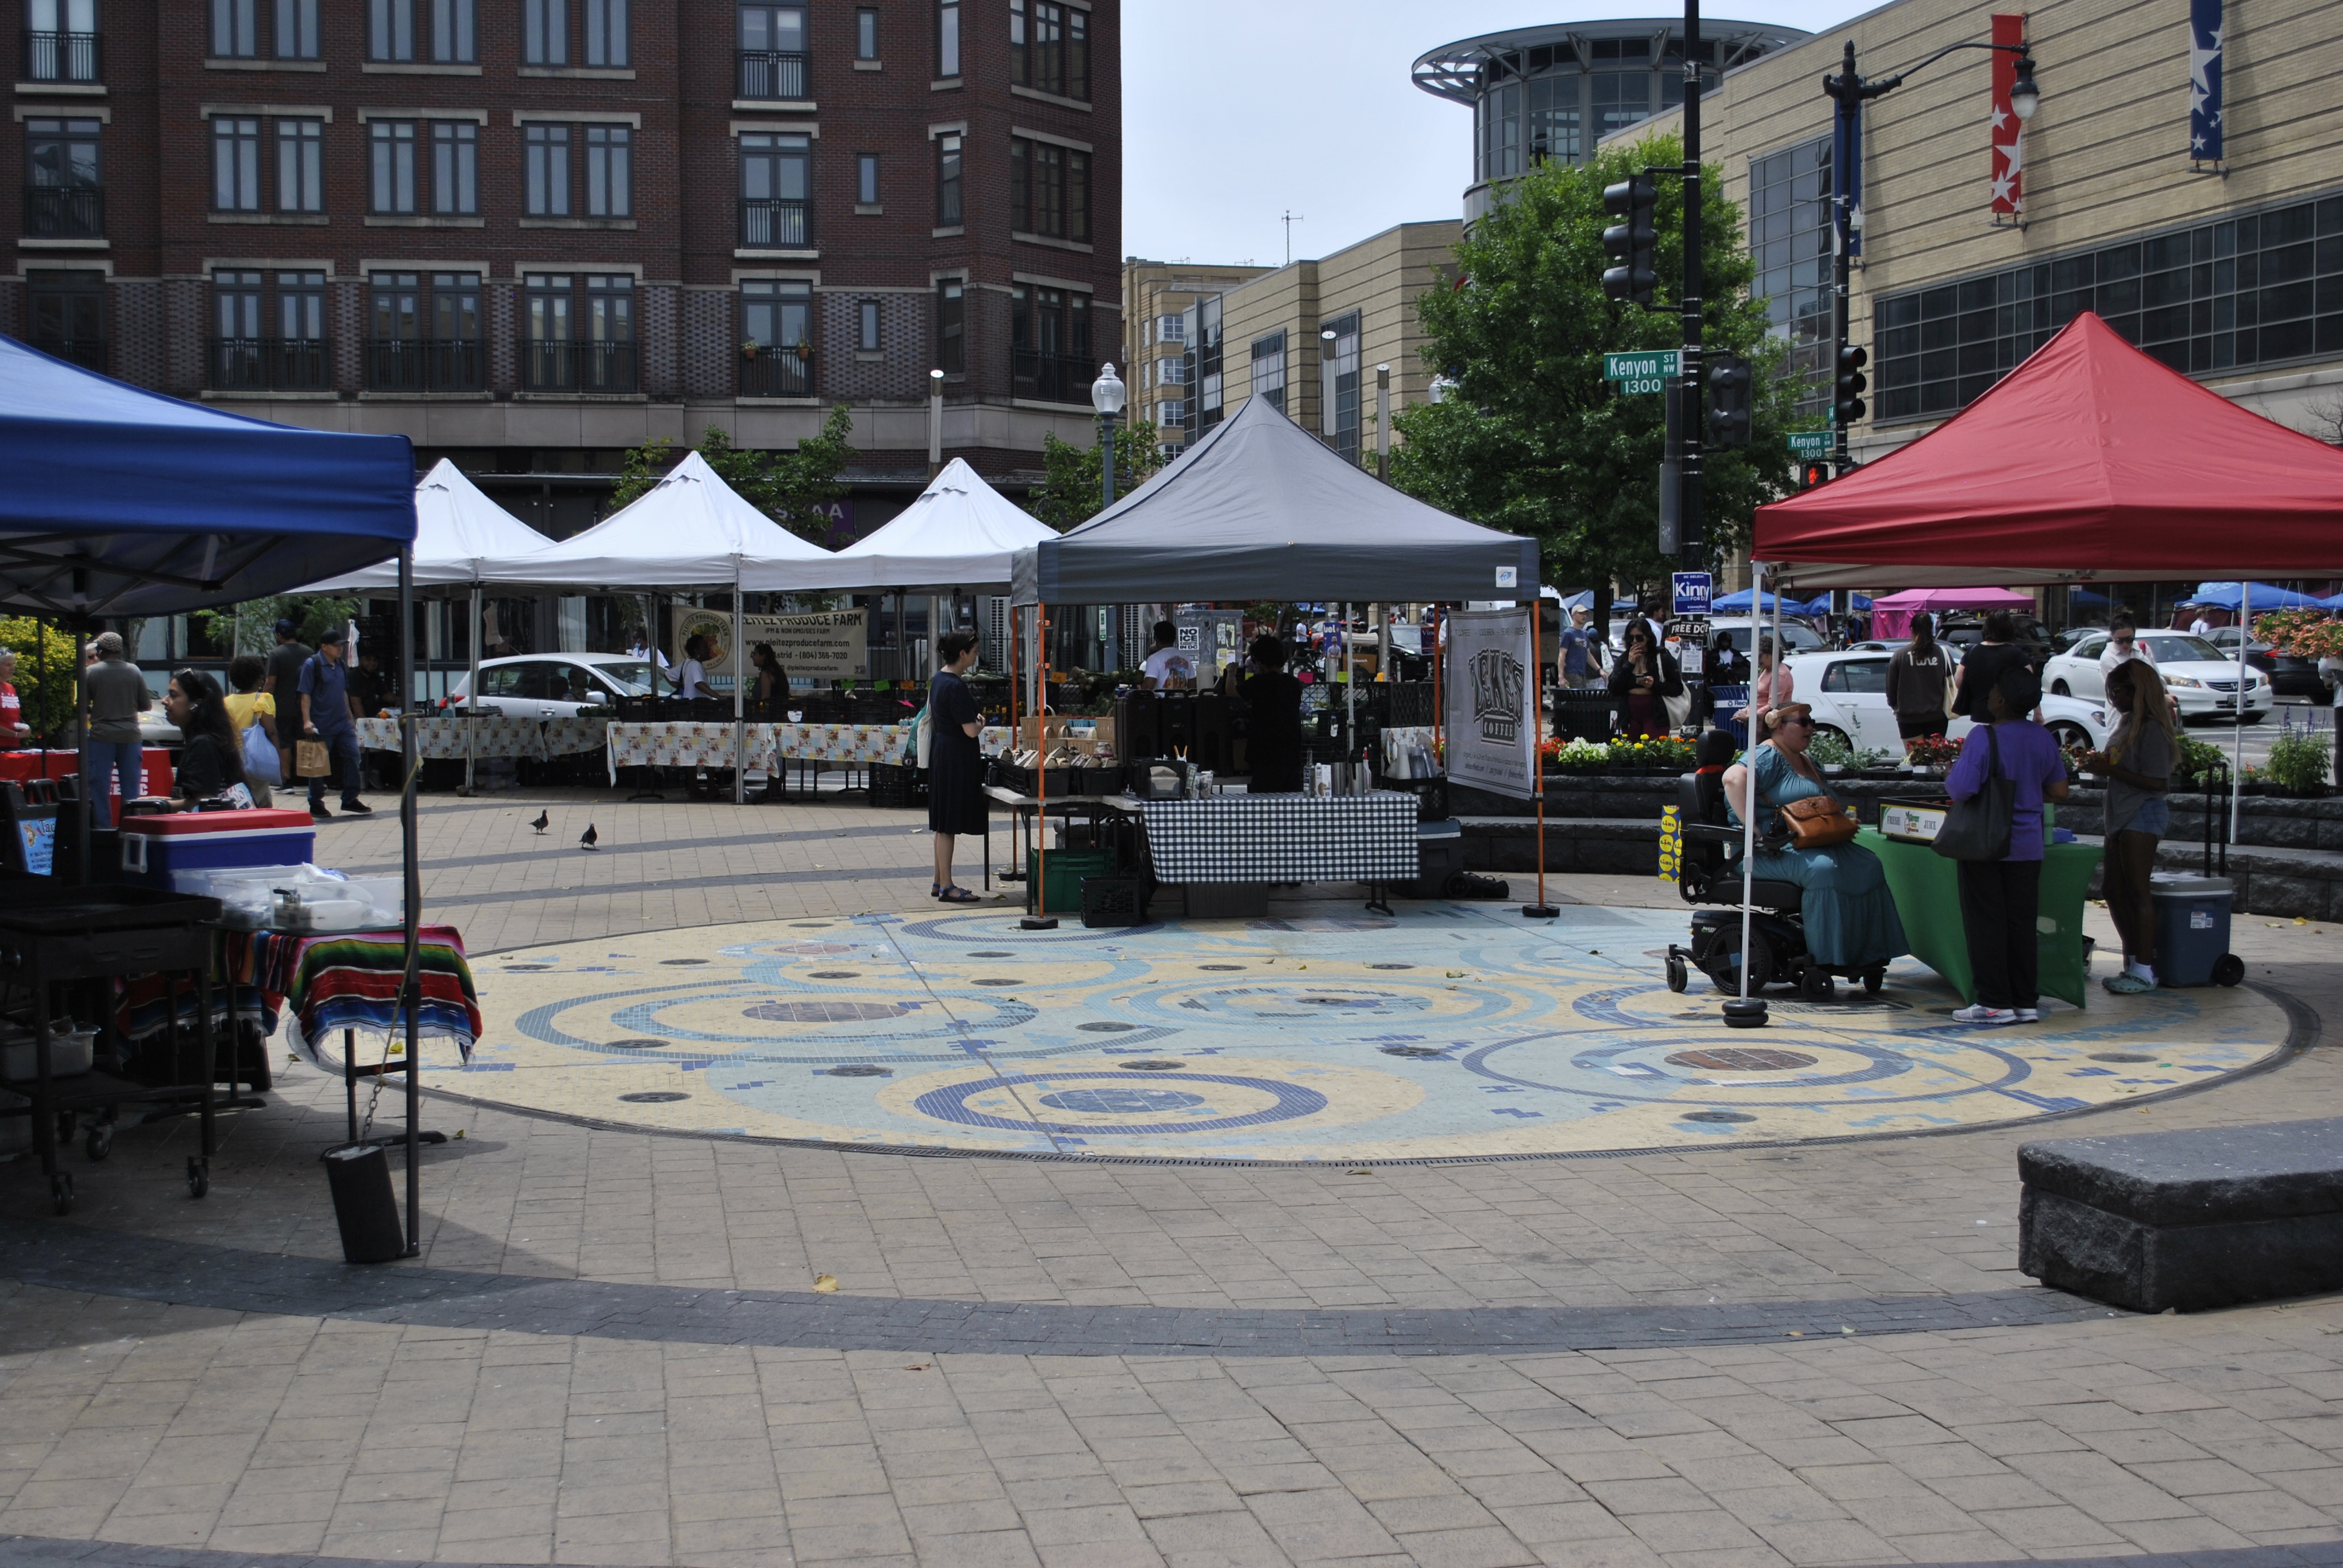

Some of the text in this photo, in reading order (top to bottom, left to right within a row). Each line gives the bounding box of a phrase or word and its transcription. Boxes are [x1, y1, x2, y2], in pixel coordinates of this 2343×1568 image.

[1610, 353, 1674, 379] Kenyon ST
[1663, 364, 1675, 373] NW
[1624, 378, 1661, 393] 1300
[1791, 436, 1820, 449] Kenyon
[1801, 449, 1822, 458] 1300
[695, 614, 719, 623] PRODUCE
[719, 622, 729, 636] FARM
[777, 615, 831, 626] PRODUCE
[834, 613, 862, 626] FARM
[1671, 624, 1691, 634] FREE
[799, 651, 817, 659] (804)
[1469, 647, 1524, 728] ZEKE'S
[1484, 722, 1513, 737] COFFEE
[1887, 815, 1901, 826] FRESH
[1924, 820, 1936, 830] JUICE
